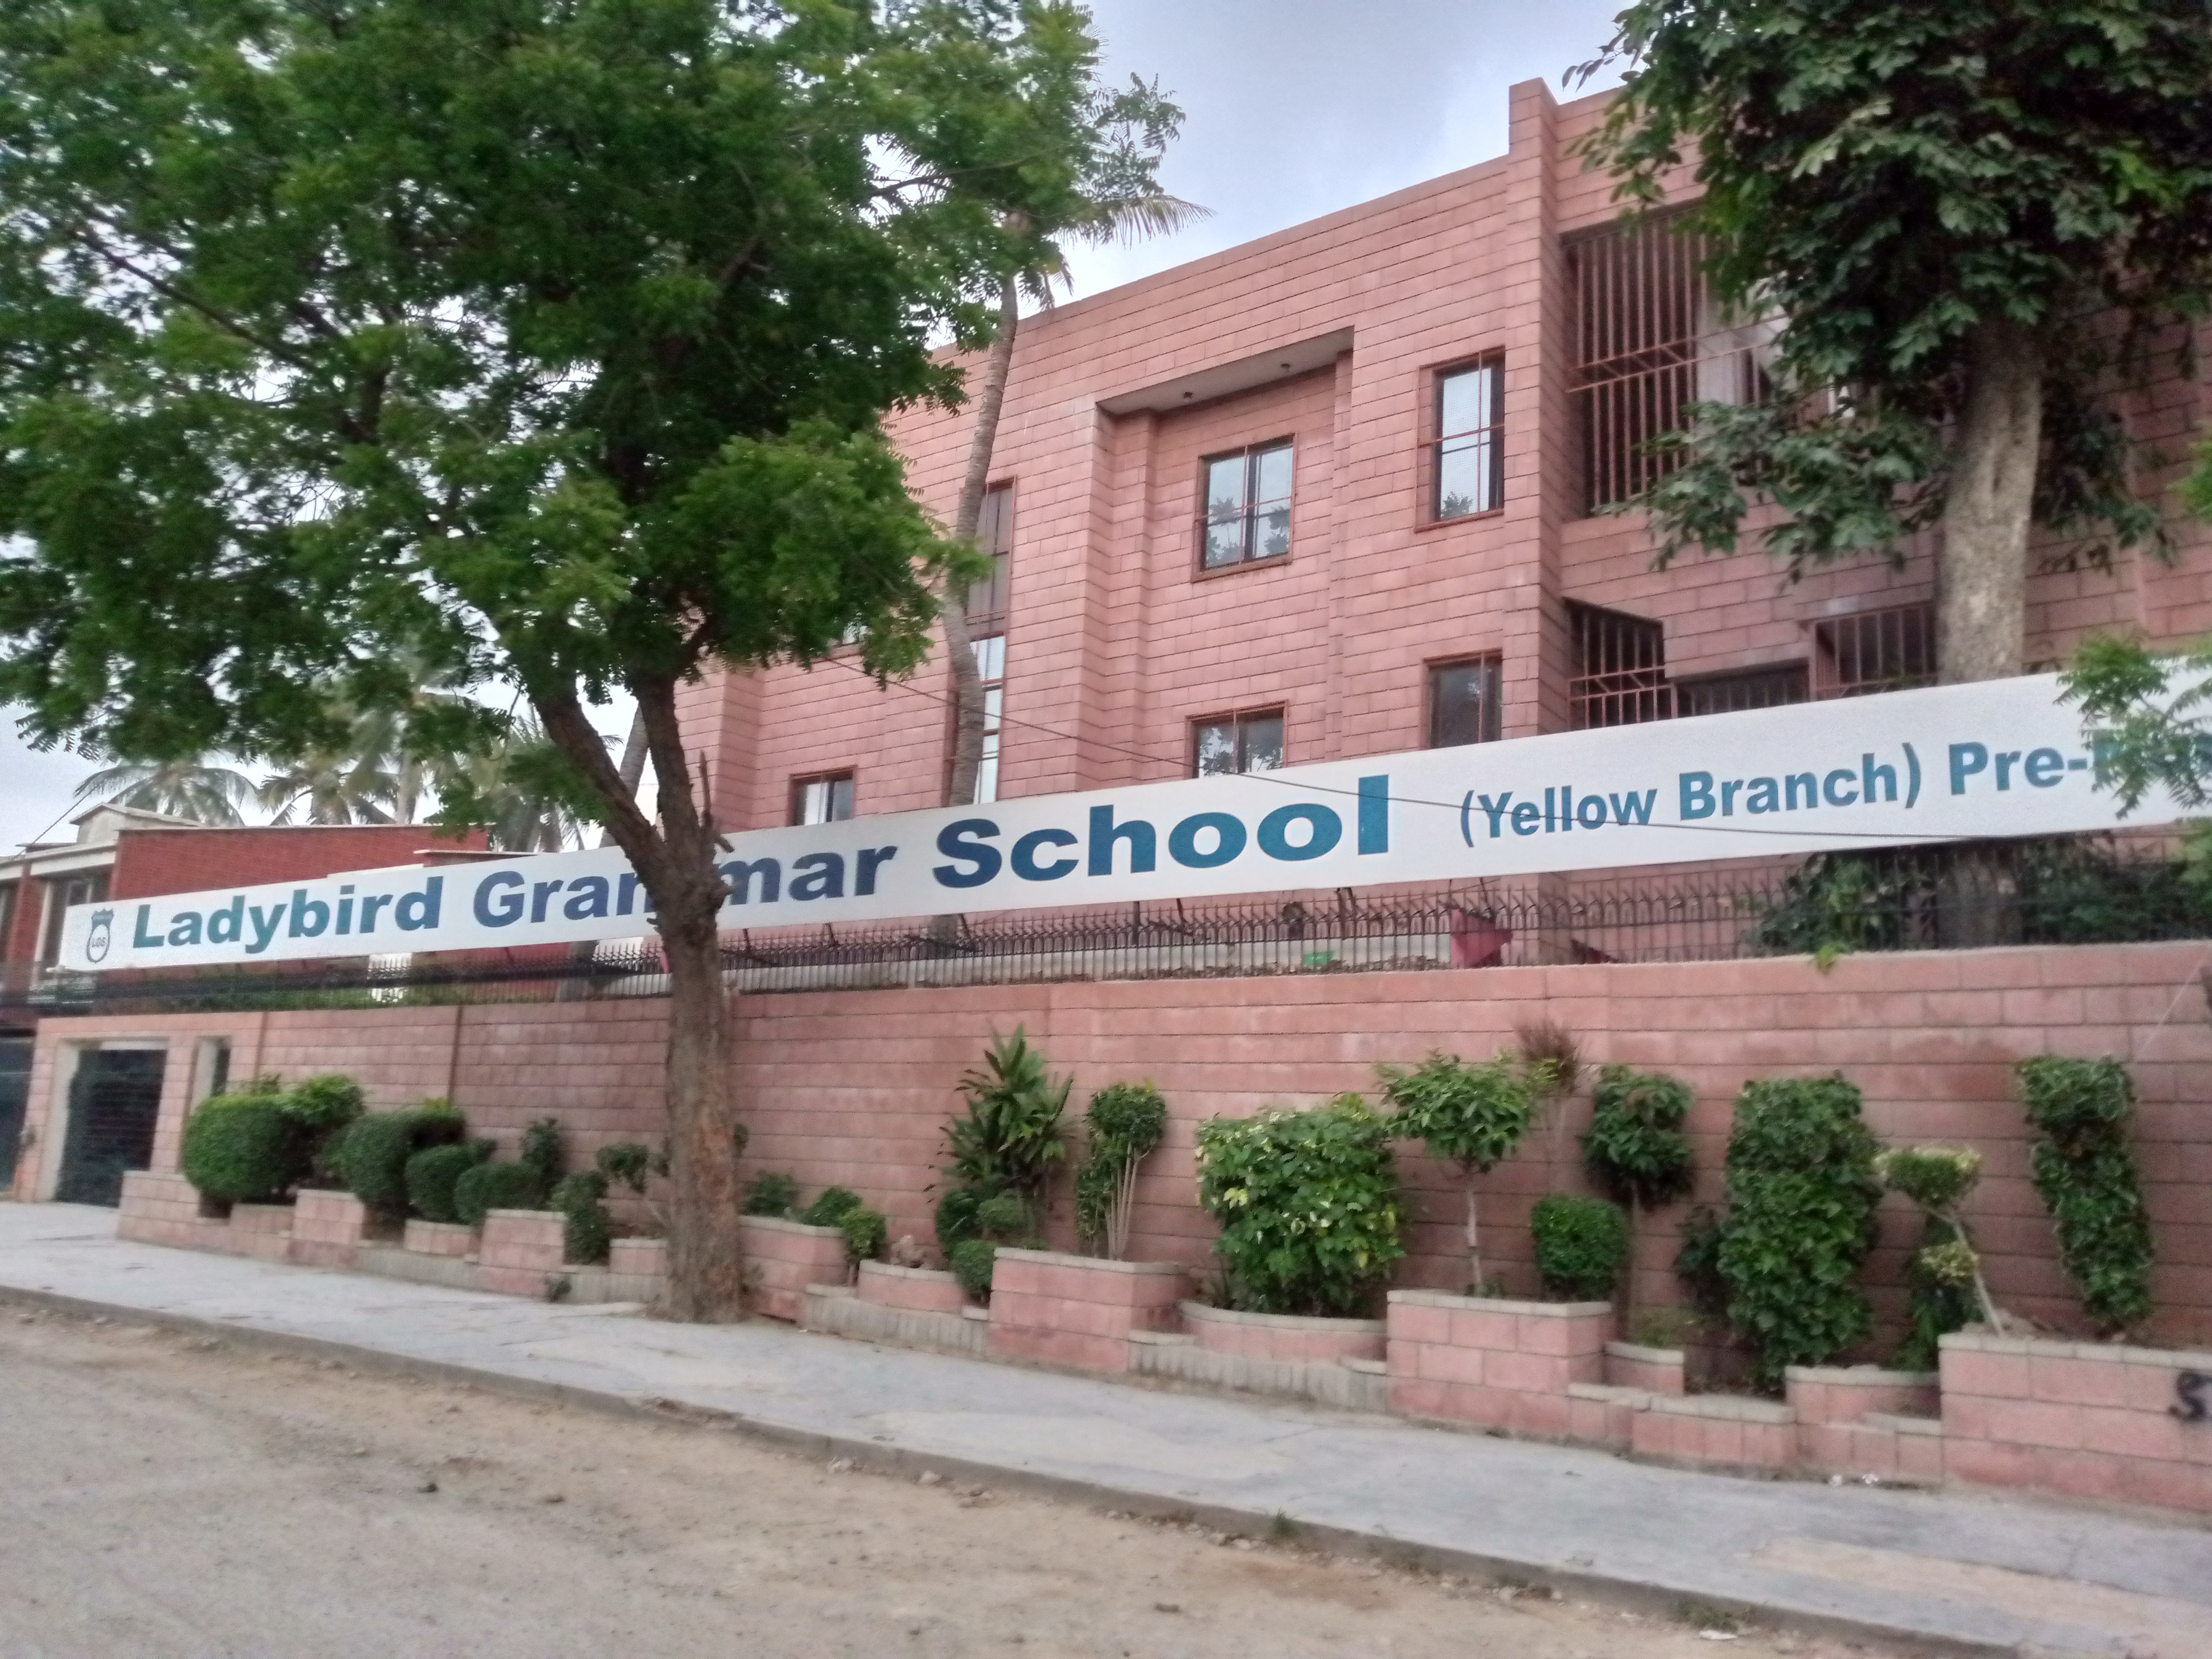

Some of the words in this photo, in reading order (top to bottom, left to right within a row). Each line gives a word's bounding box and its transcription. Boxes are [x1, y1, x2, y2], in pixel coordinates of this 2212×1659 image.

[132, 876, 444, 954] Ladybird
[932, 774, 1389, 888] School
[1460, 790, 1657, 848] (Yellow
[1679, 742, 1921, 821] Branch)
